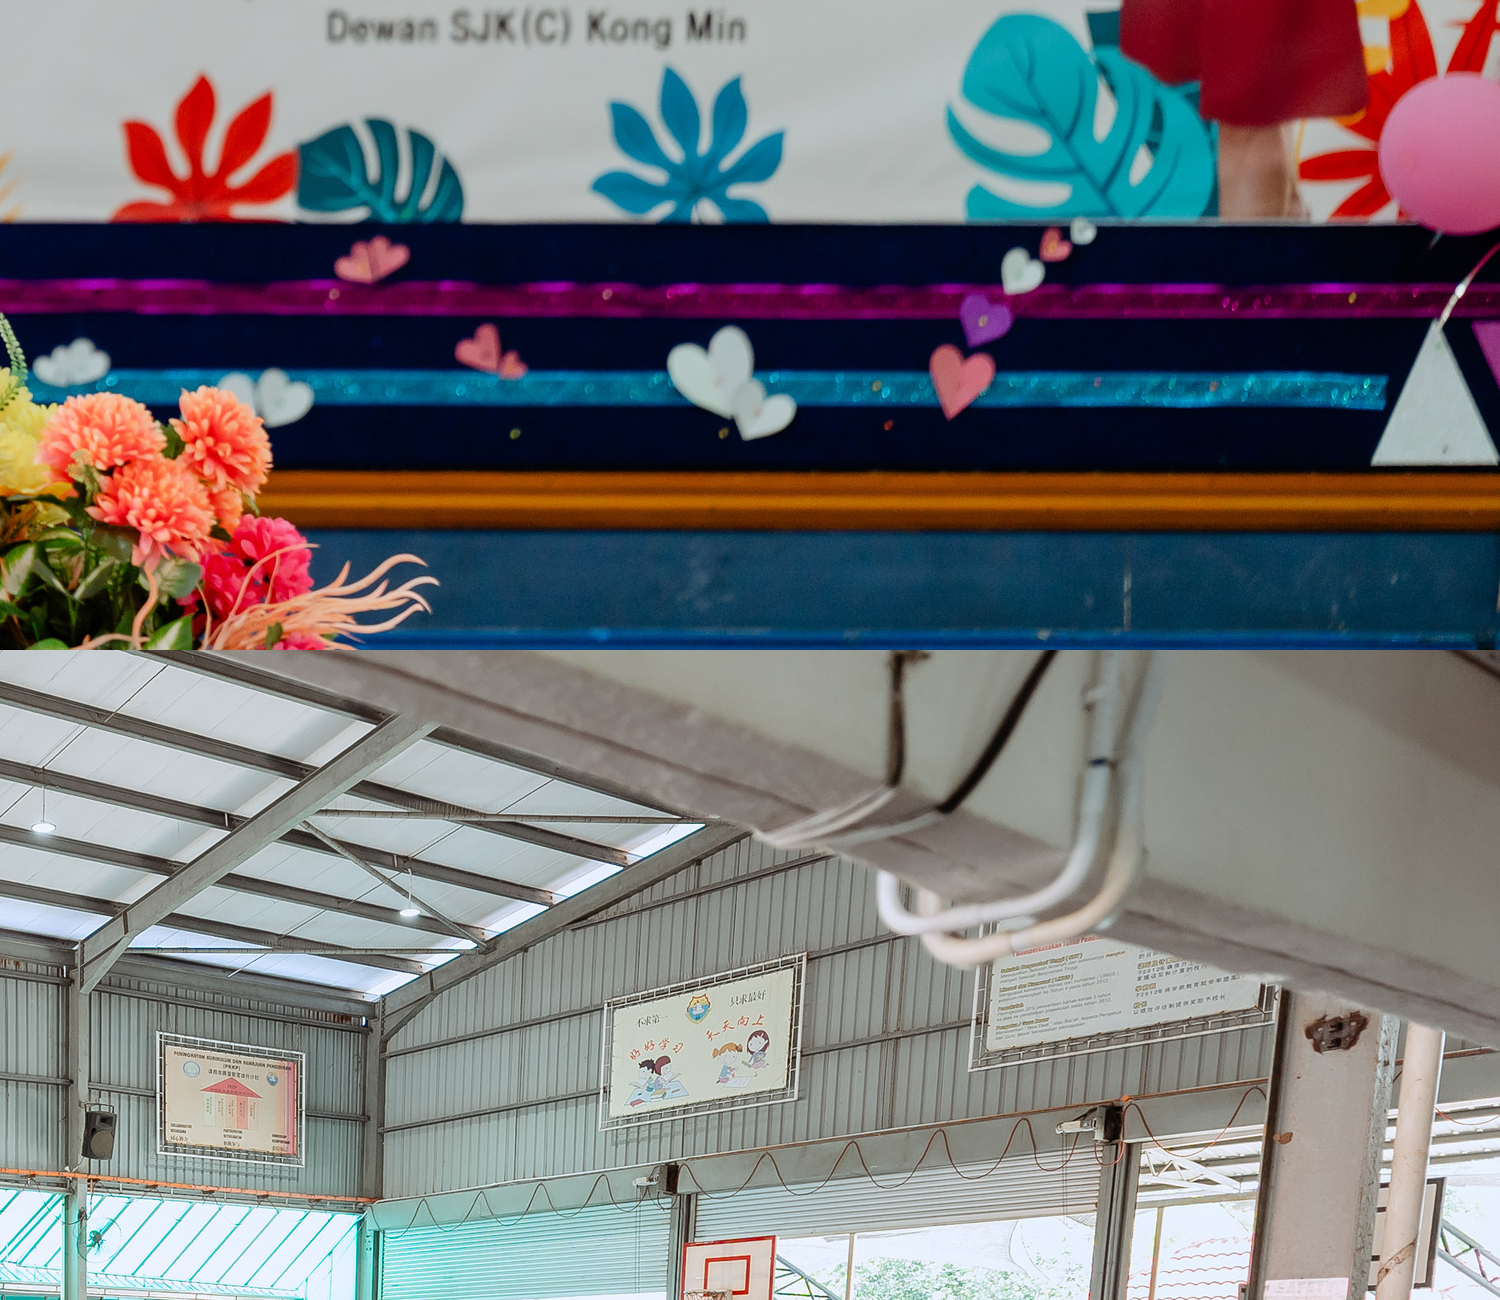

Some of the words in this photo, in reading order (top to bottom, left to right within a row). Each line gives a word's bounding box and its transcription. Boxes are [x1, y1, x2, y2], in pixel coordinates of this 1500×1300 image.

[327, 11, 439, 45] Dewan
[450, 11, 572, 47] SJK(C)
[586, 11, 673, 51] Kong
[685, 10, 747, 44] Min
[636, 1014, 668, 1027] 不求第一
[730, 990, 766, 1006] 只求最好
[706, 1014, 764, 1041] 天天向上
[630, 1038, 684, 1060] 好好学习
